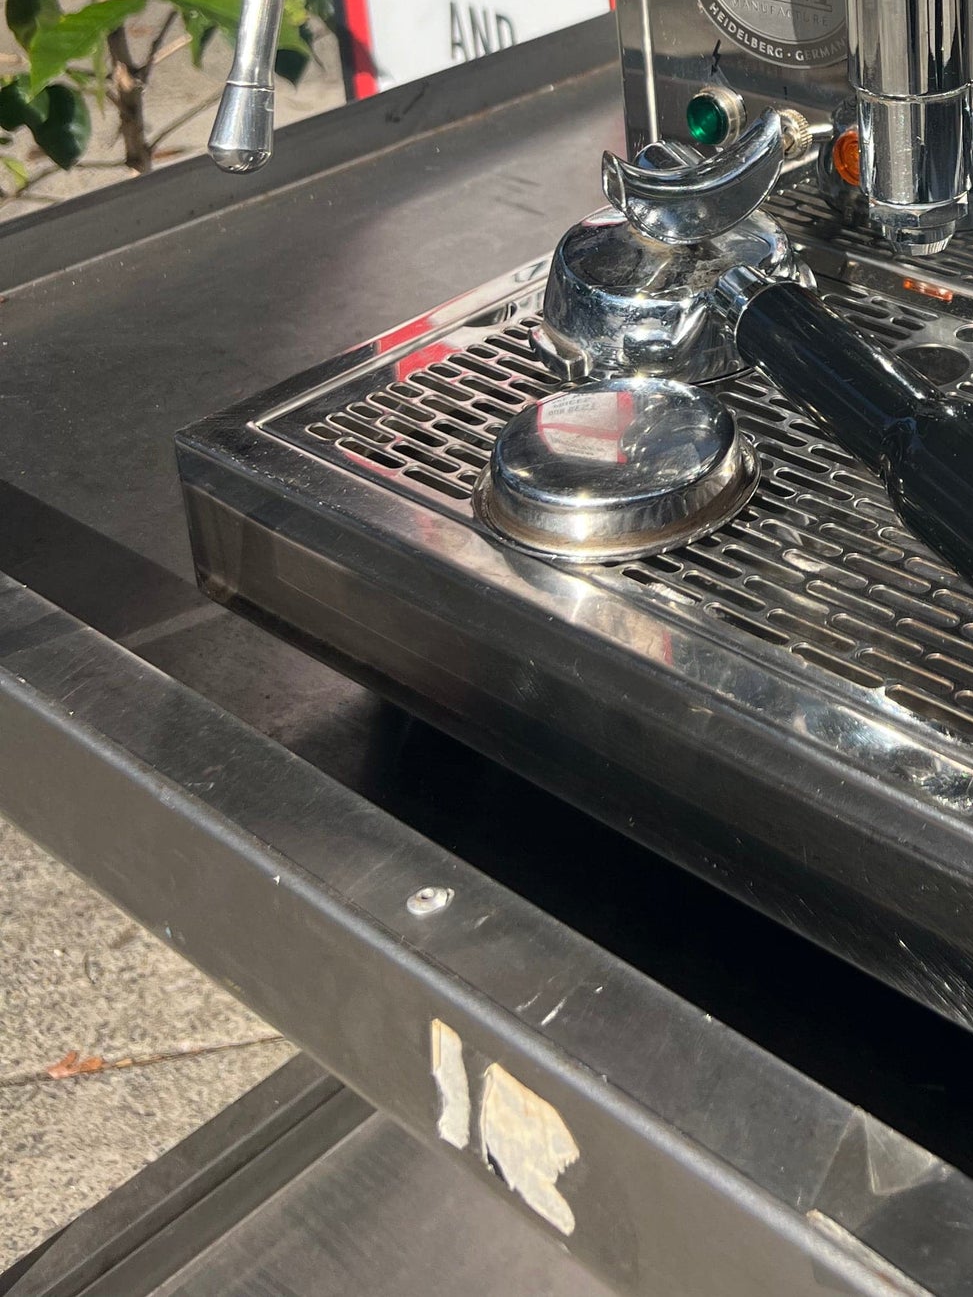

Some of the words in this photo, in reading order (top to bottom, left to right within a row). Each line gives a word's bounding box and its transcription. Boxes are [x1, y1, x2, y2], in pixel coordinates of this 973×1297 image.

[450, 1, 518, 62] AND
[709, 2, 784, 59] HEIDELBERG
[795, 38, 847, 61] GERMAN
